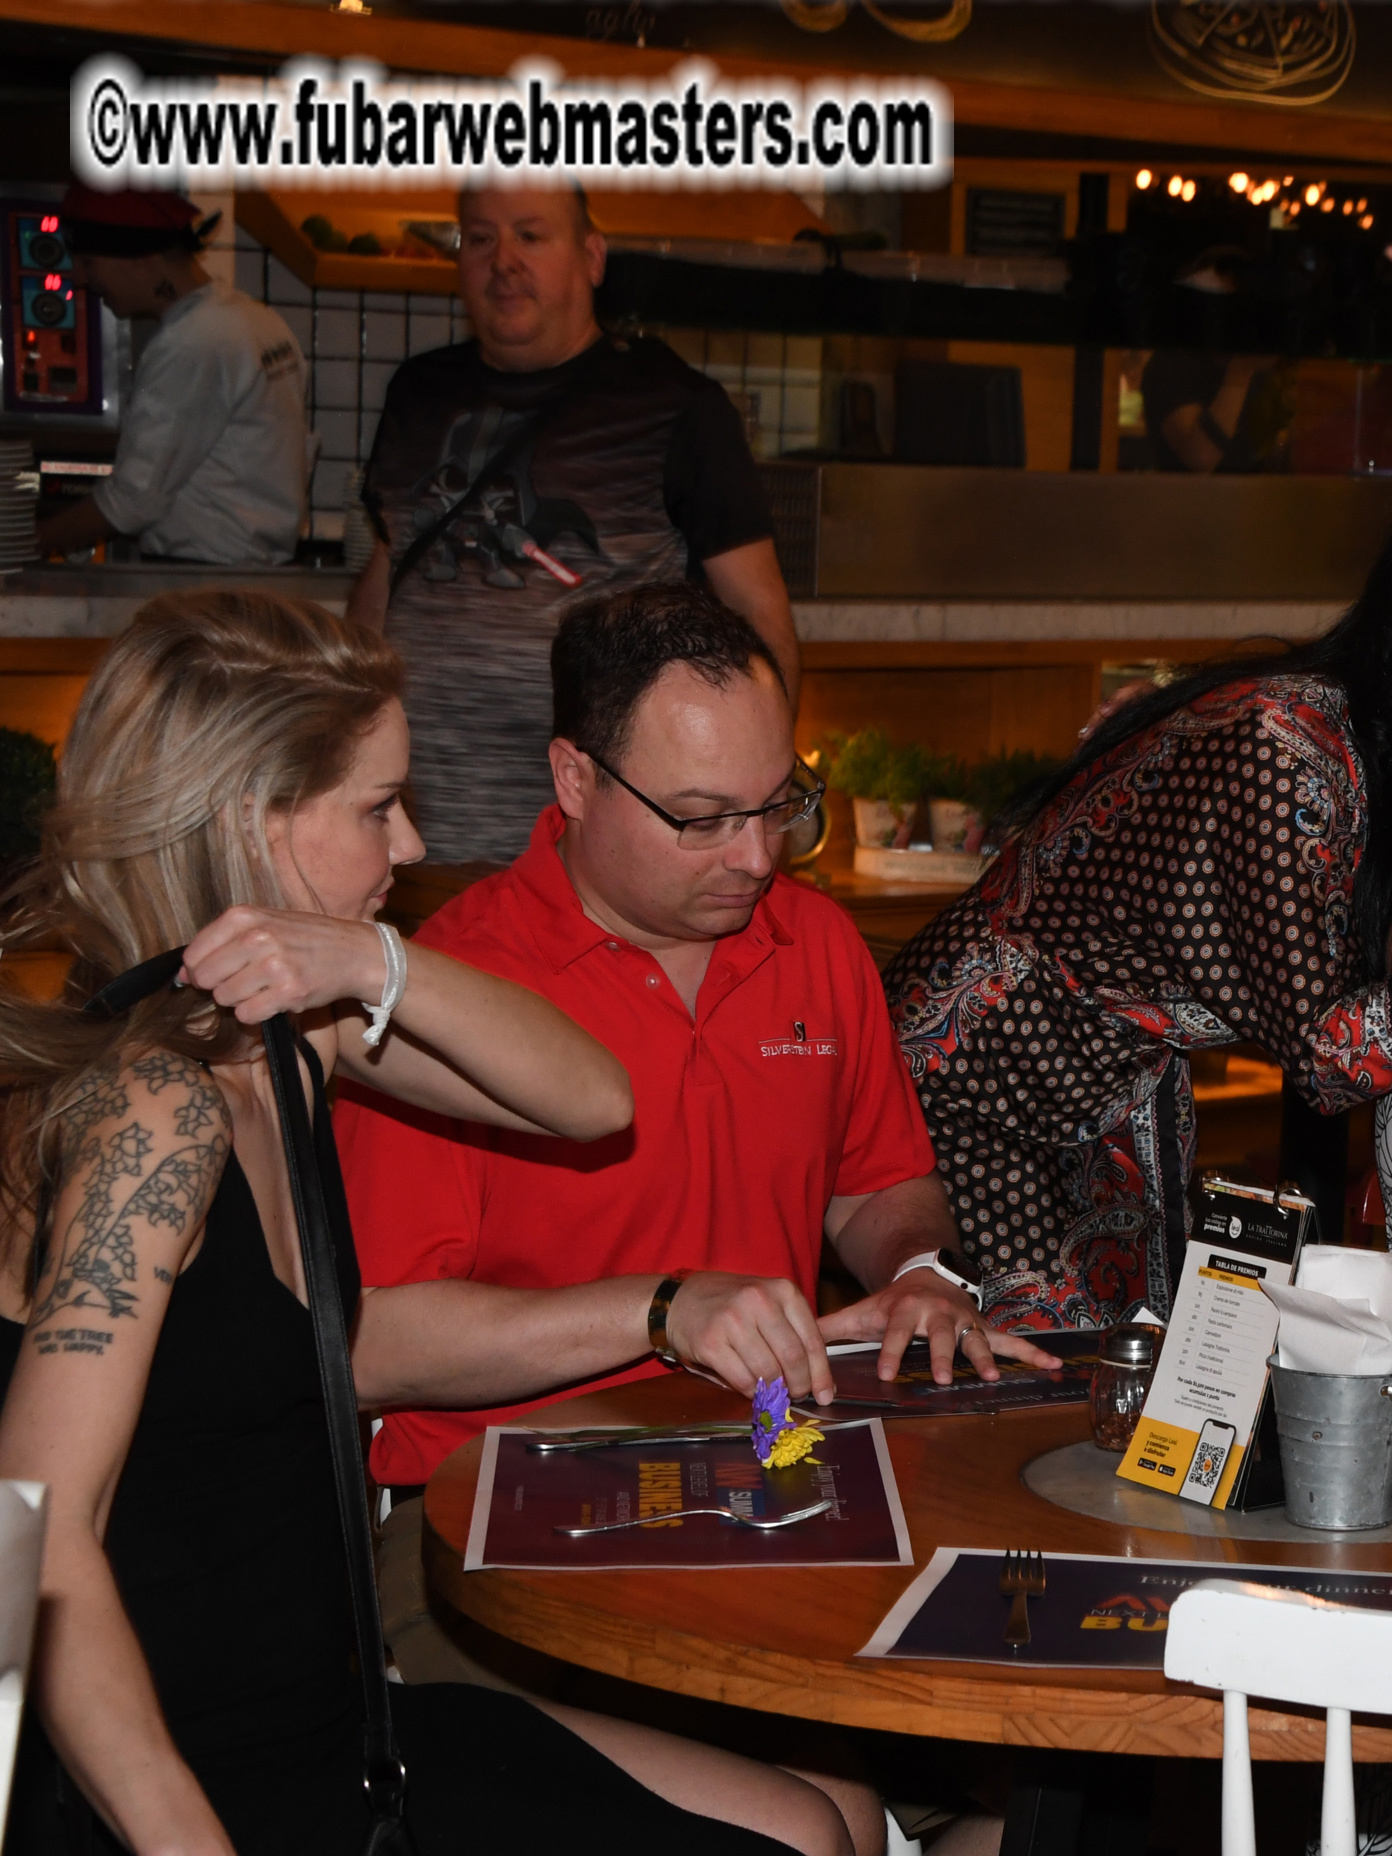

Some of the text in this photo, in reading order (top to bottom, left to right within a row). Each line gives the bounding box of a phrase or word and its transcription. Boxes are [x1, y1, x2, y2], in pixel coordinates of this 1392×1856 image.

[1204, 1223, 1226, 1234] premios
[1215, 1260, 1230, 1270] TABLA
[1237, 1265, 1259, 1277] PREMIOS
[1149, 1431, 1168, 1443] Descarga
[1149, 1440, 1170, 1452] comienza
[1147, 1447, 1166, 1458] disfrutar
[638, 1461, 684, 1528] BUSINESS
